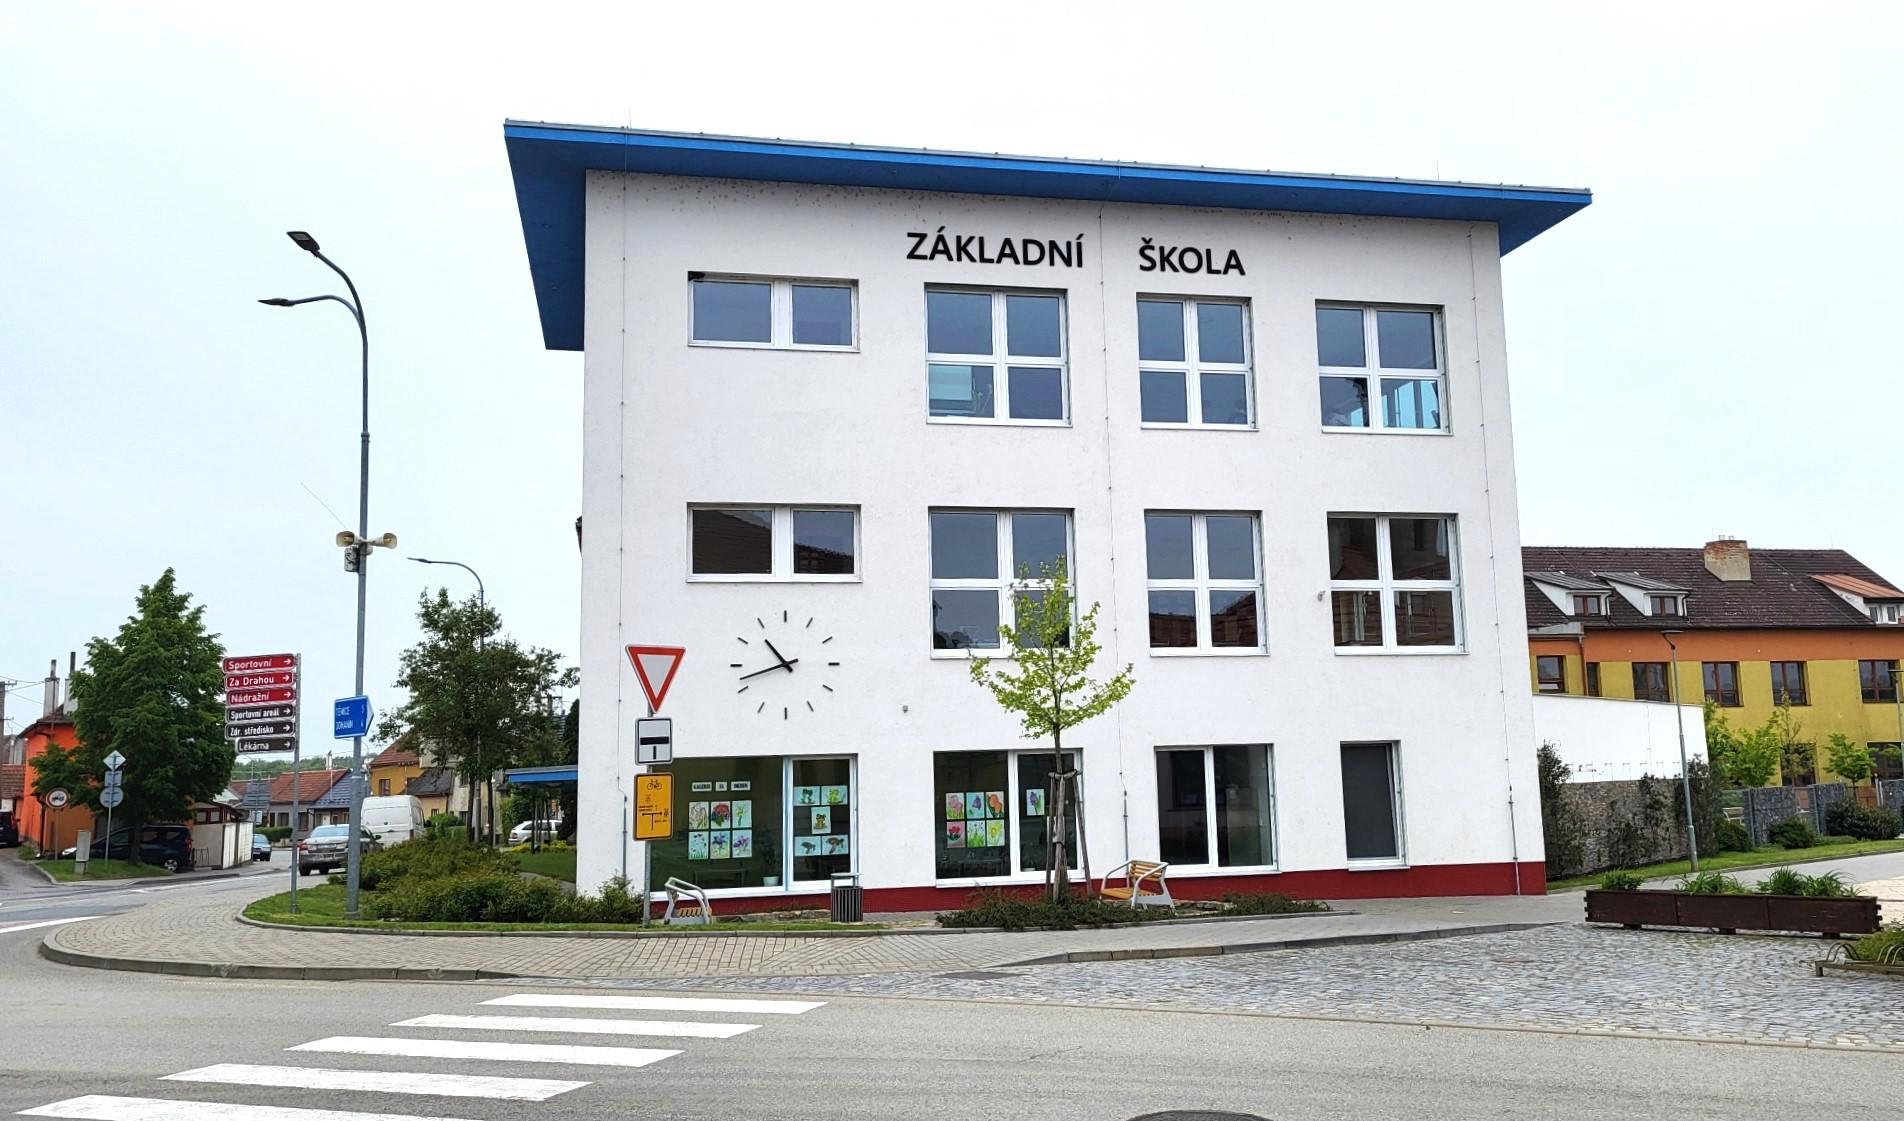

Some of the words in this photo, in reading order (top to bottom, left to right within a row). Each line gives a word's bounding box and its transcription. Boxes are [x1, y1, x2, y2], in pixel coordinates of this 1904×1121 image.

[906, 226, 1084, 268] ZÁKLADNÍ
[1138, 237, 1246, 276] ŠKOLA
[228, 659, 272, 671] Sportovní
[229, 677, 240, 687] Za
[243, 676, 274, 686] Drahou
[231, 691, 270, 703] Nádražní
[230, 709, 262, 721] Sportovní
[262, 707, 280, 717] areál
[230, 727, 243, 737] Zdr.
[244, 725, 274, 736] středisko
[239, 741, 270, 751] Lékárna
